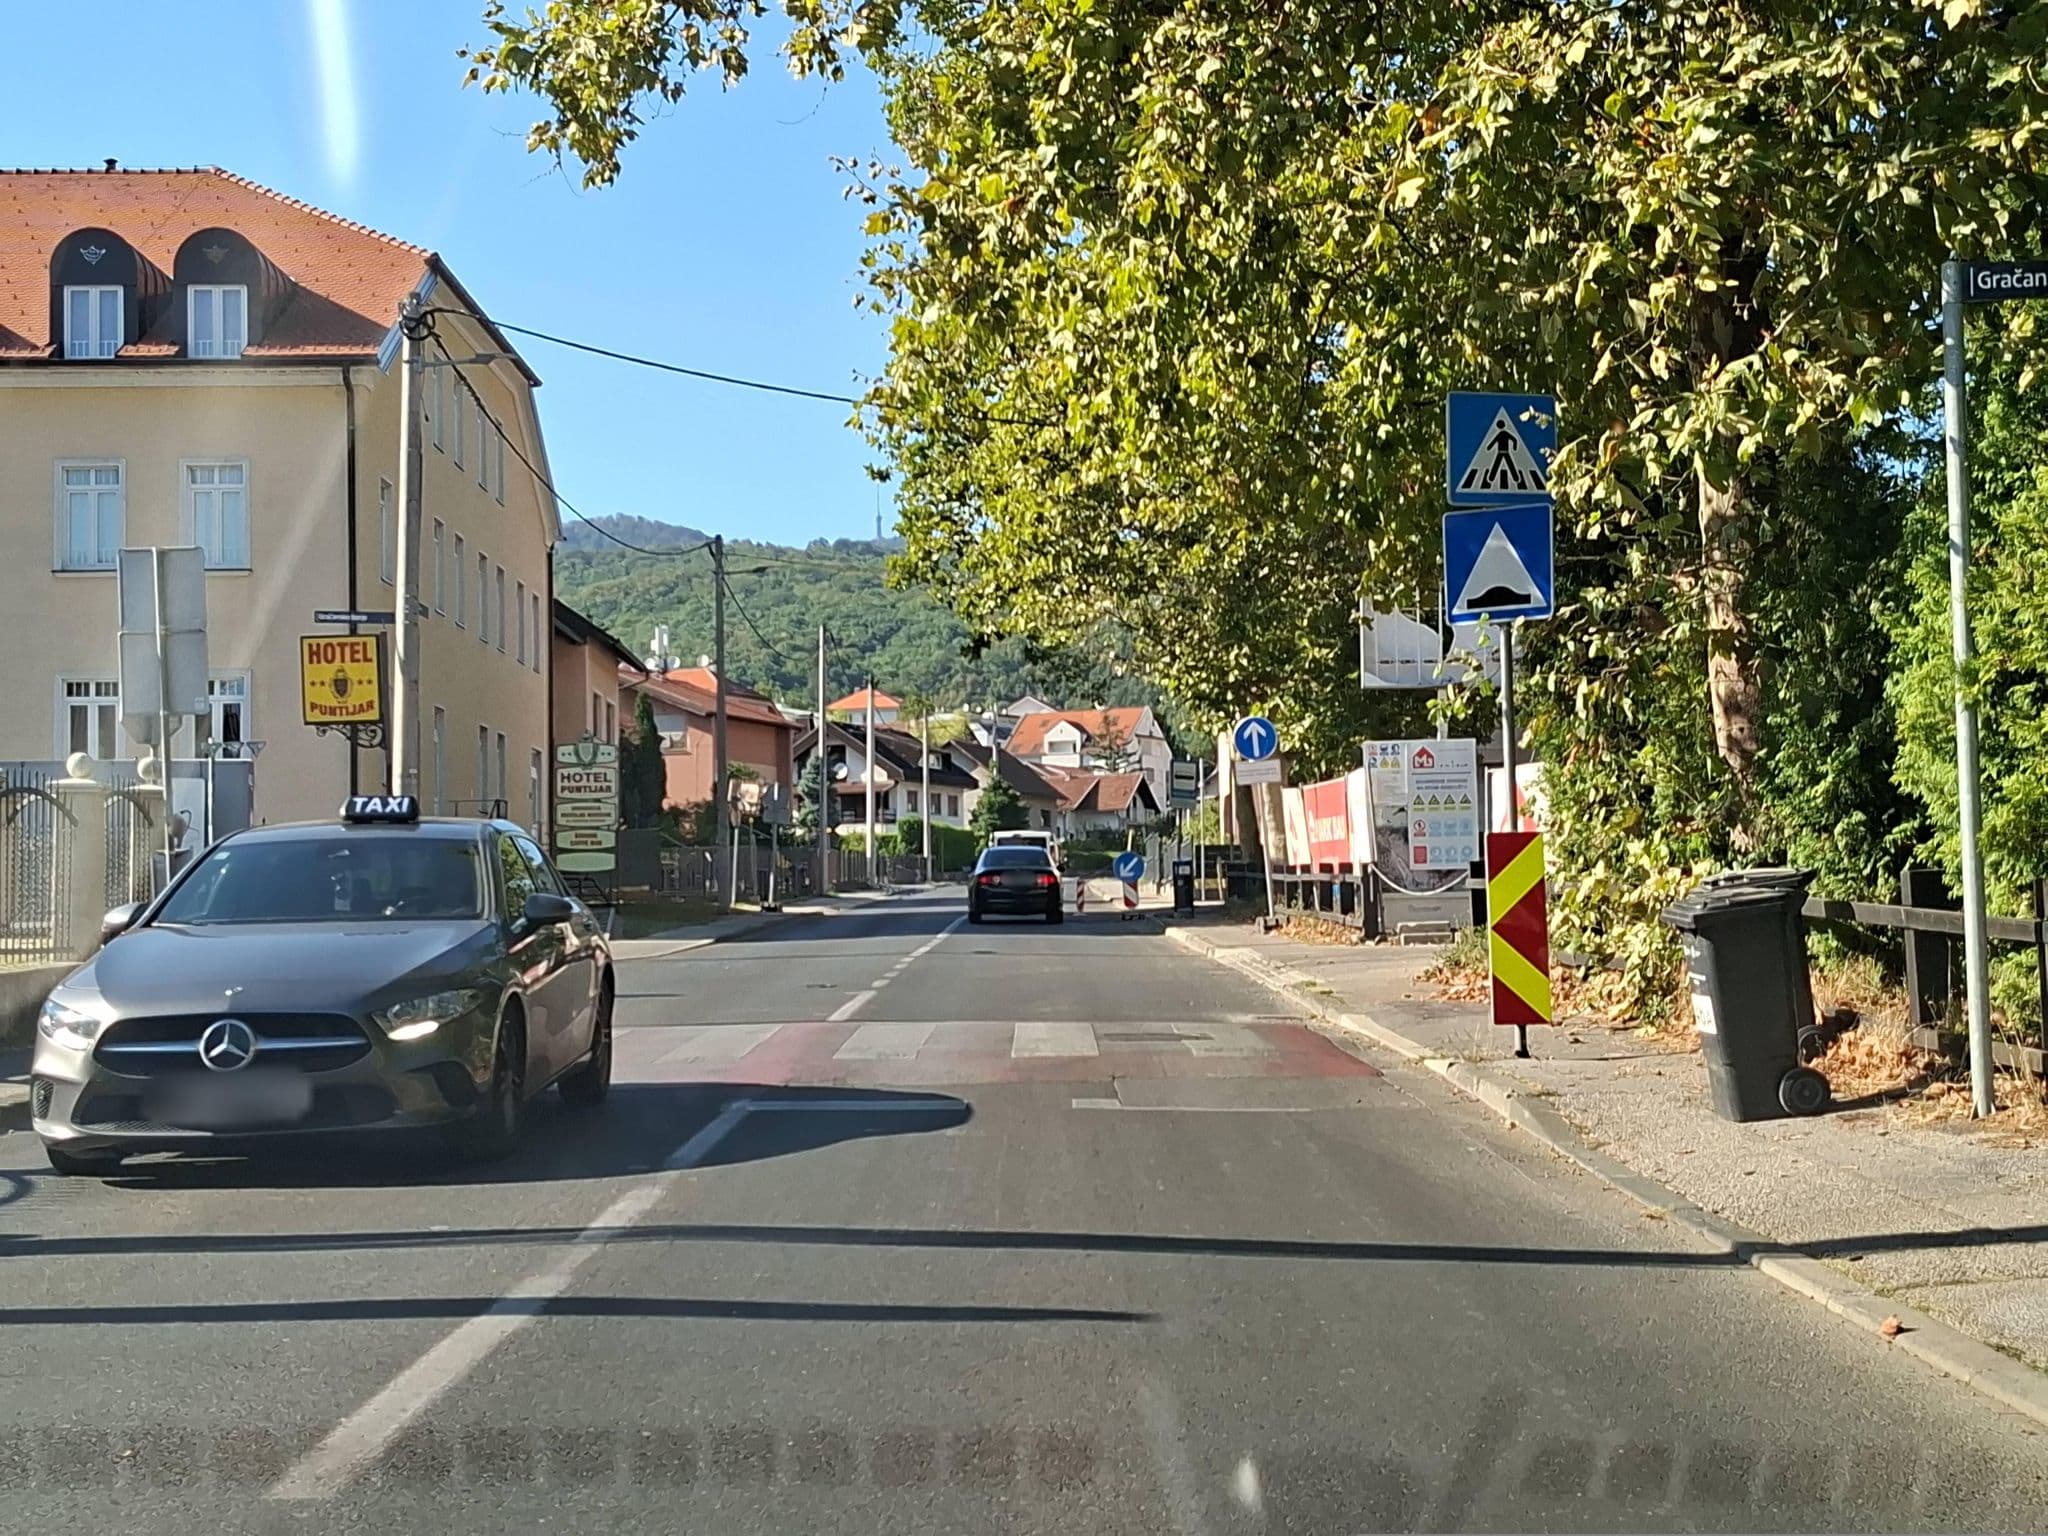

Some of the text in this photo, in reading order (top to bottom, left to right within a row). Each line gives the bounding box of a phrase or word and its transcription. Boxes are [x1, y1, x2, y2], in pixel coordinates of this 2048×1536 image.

[308, 641, 373, 664] HOTEL
[560, 772, 613, 783] HOTEL
[352, 797, 410, 813] TAXI
